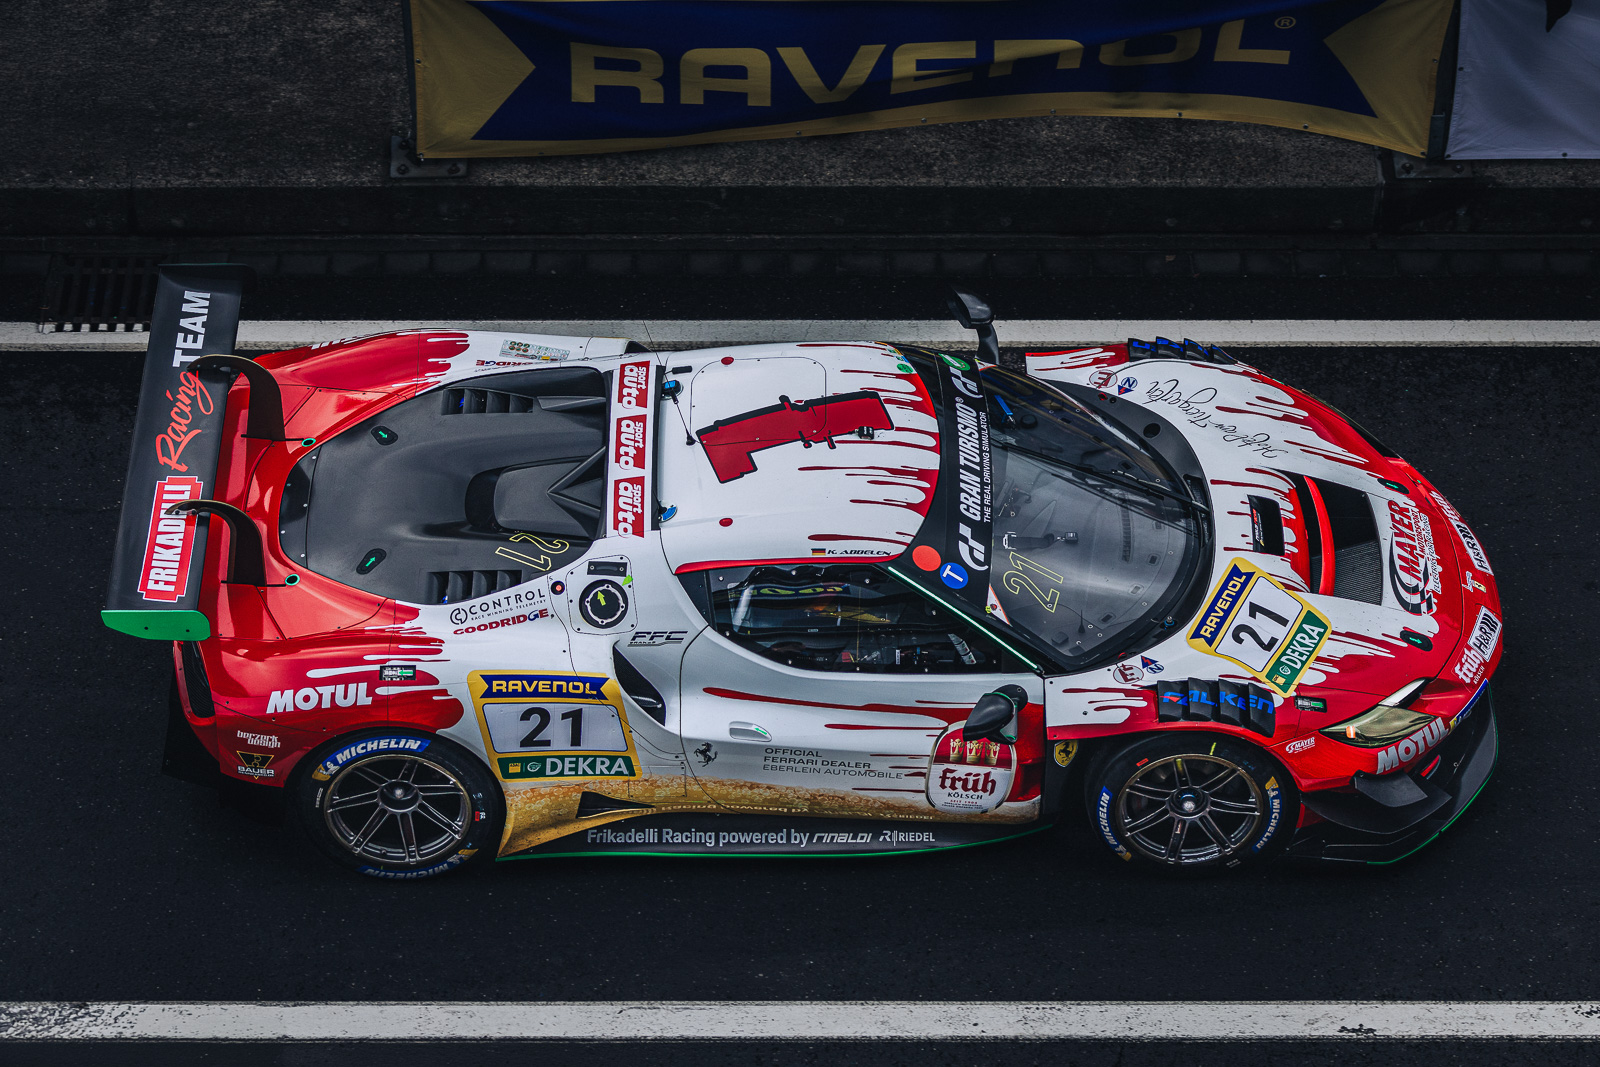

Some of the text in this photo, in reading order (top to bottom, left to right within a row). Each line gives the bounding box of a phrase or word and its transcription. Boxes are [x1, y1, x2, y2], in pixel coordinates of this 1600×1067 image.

[173, 290, 211, 367] TEAM
[622, 365, 639, 409] auto
[637, 365, 646, 389] sport
[1142, 379, 1217, 428] Tiergarten
[156, 370, 214, 472] Racing
[635, 421, 643, 449] sport
[619, 419, 636, 470] auto
[979, 411, 991, 523] THE REAL DRIVING SIMULATOR
[617, 481, 634, 538] auto
[632, 483, 641, 514] sport
[960, 470, 981, 522] GRAN
[1388, 500, 1422, 583] MAYER
[943, 565, 964, 583] T
[1003, 552, 1064, 613] 21
[469, 588, 546, 615] CONTROL
[487, 608, 513, 617] WINNING
[516, 599, 546, 610] TELEMETRY
[1200, 575, 1246, 638] RAVENOL
[453, 608, 549, 635] GOODRIDGE
[1232, 601, 1289, 652] 21
[1280, 623, 1325, 669] DEKRA
[1455, 648, 1484, 684] früh
[266, 682, 373, 714] MOTUL
[492, 680, 597, 695] RAVENOL
[520, 707, 583, 748] 21
[336, 739, 422, 765] MICHELIN
[765, 747, 822, 758] OFFICIAL
[1376, 717, 1448, 775] MOTUL
[238, 766, 274, 774] BAUER
[545, 757, 629, 775] DEKRA
[763, 764, 903, 780] EBERLEIN AUTOMOBILE
[764, 756, 871, 769] FERRARI DEALER
[939, 768, 997, 796] früh
[947, 792, 983, 800] KÖLSCH
[1100, 792, 1117, 846] MICHELIN
[1257, 799, 1281, 849] MICHELIN
[587, 828, 658, 843] Frikadelli
[662, 828, 715, 847] Racing
[719, 829, 787, 847] powered
[791, 829, 809, 847] by
[898, 832, 936, 842] RIEDEL
[364, 861, 449, 880] MICHELIN
